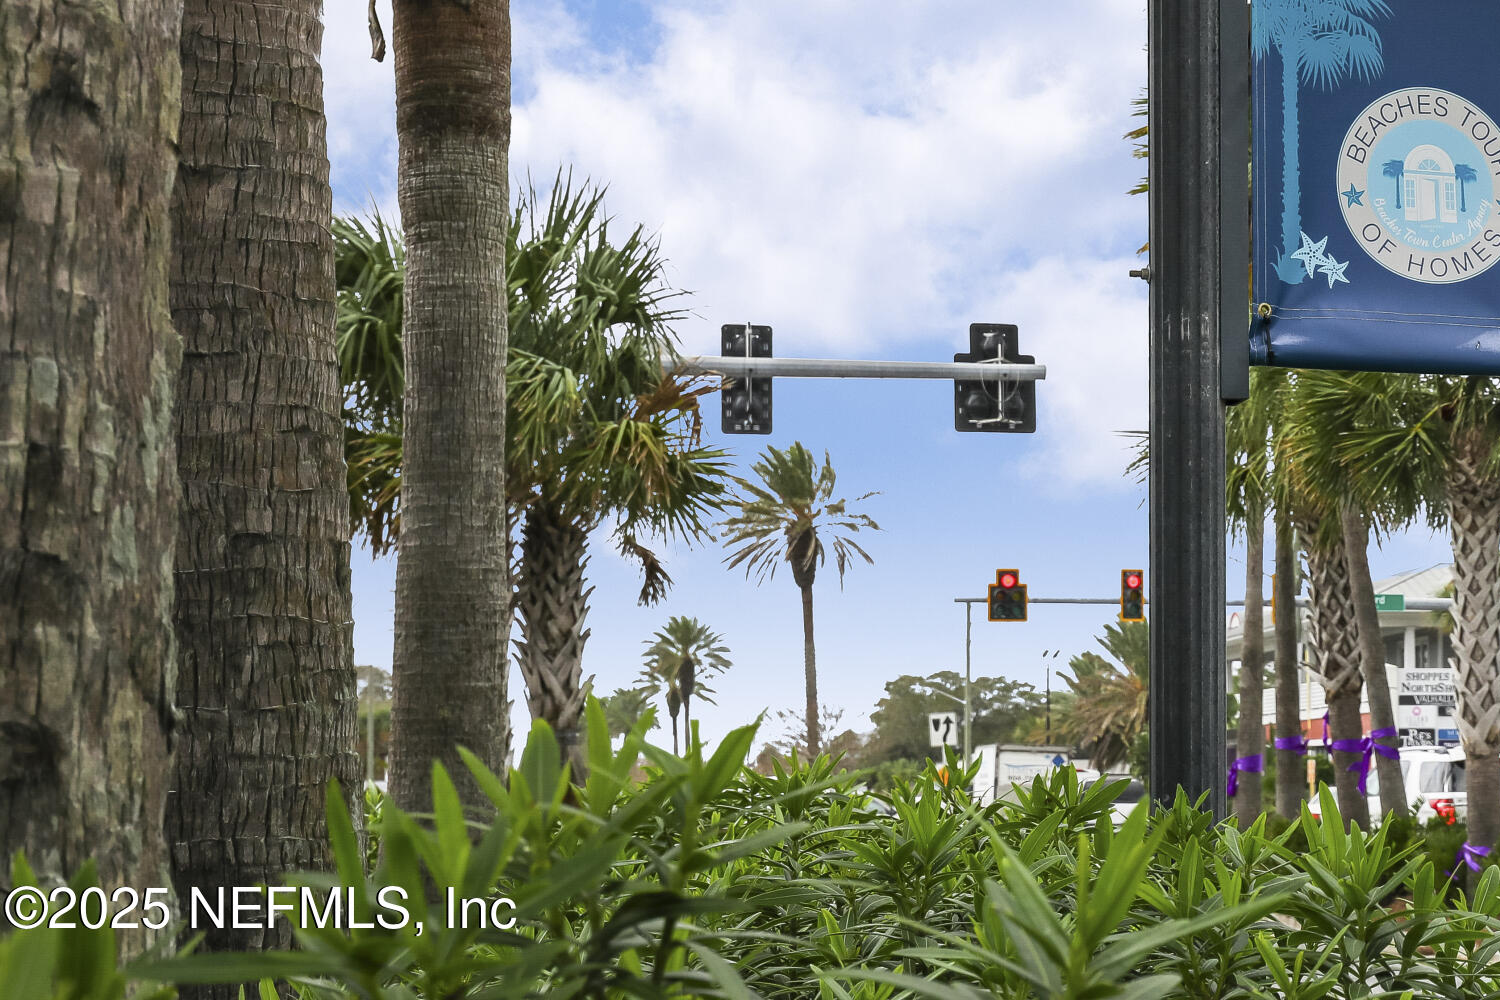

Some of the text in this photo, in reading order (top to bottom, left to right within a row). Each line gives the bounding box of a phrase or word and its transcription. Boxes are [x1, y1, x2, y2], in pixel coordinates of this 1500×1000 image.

[1346, 94, 1449, 164] BEACHES
[1362, 223, 1397, 255] OF
[1403, 227, 1430, 247] Town
[1432, 231, 1465, 249] Center
[1467, 198, 1492, 237] Agency
